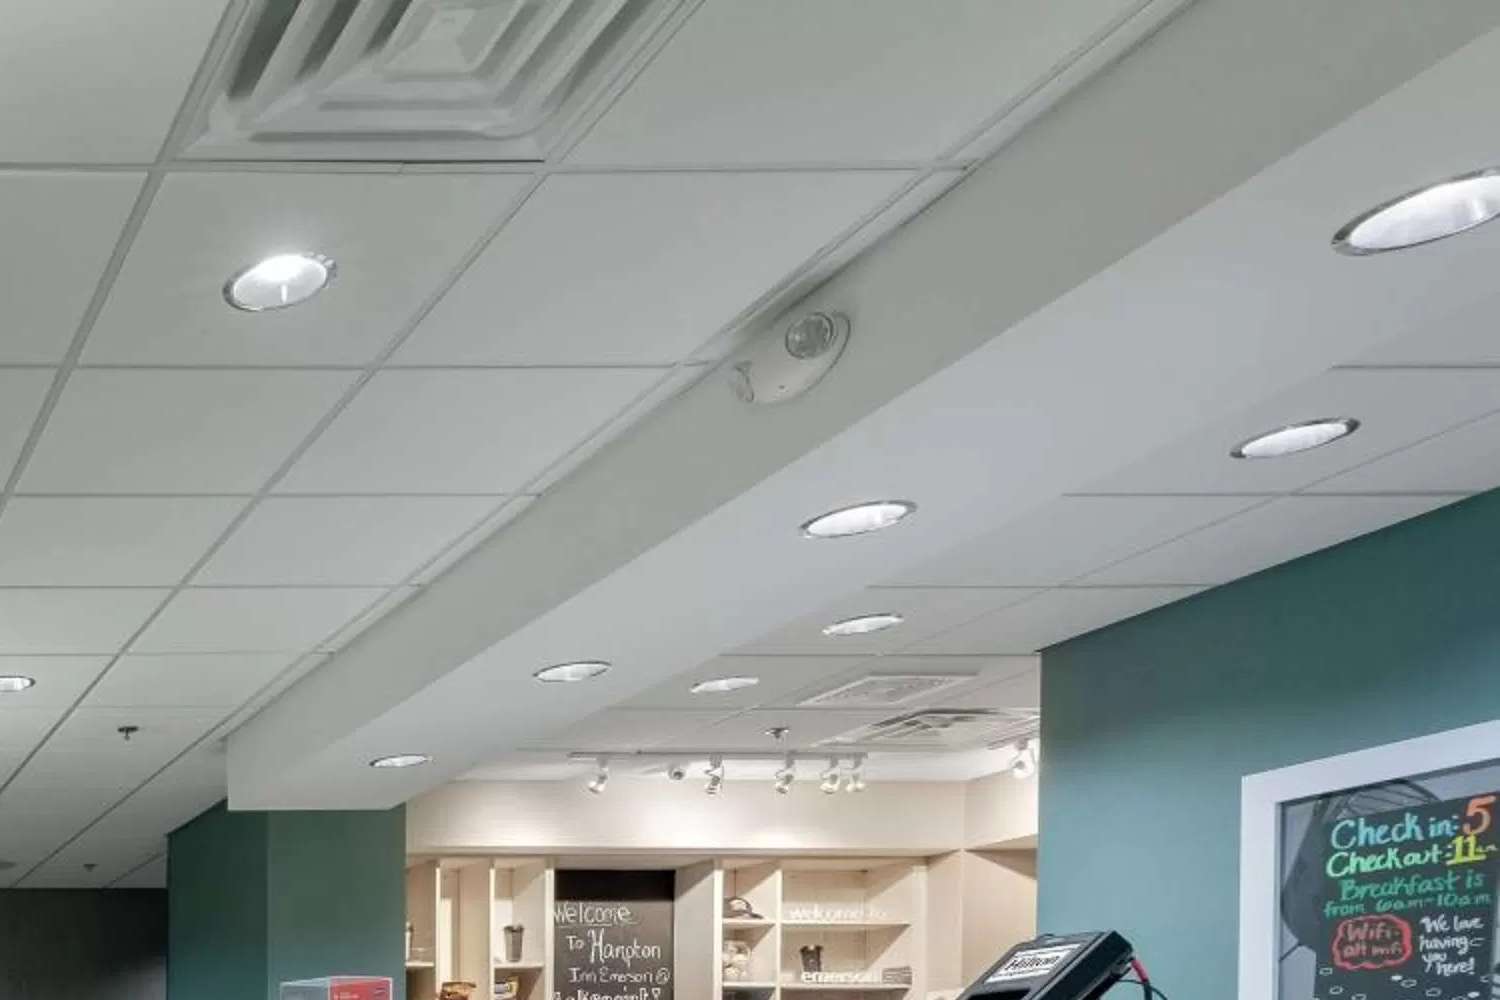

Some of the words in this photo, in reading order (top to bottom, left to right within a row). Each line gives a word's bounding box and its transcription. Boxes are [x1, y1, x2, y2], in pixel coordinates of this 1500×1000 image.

[1331, 811, 1424, 851] Check
[1339, 869, 1460, 902] Breakfast
[1464, 868, 1486, 890] is
[1323, 901, 1365, 919] from
[1420, 913, 1451, 933] We
